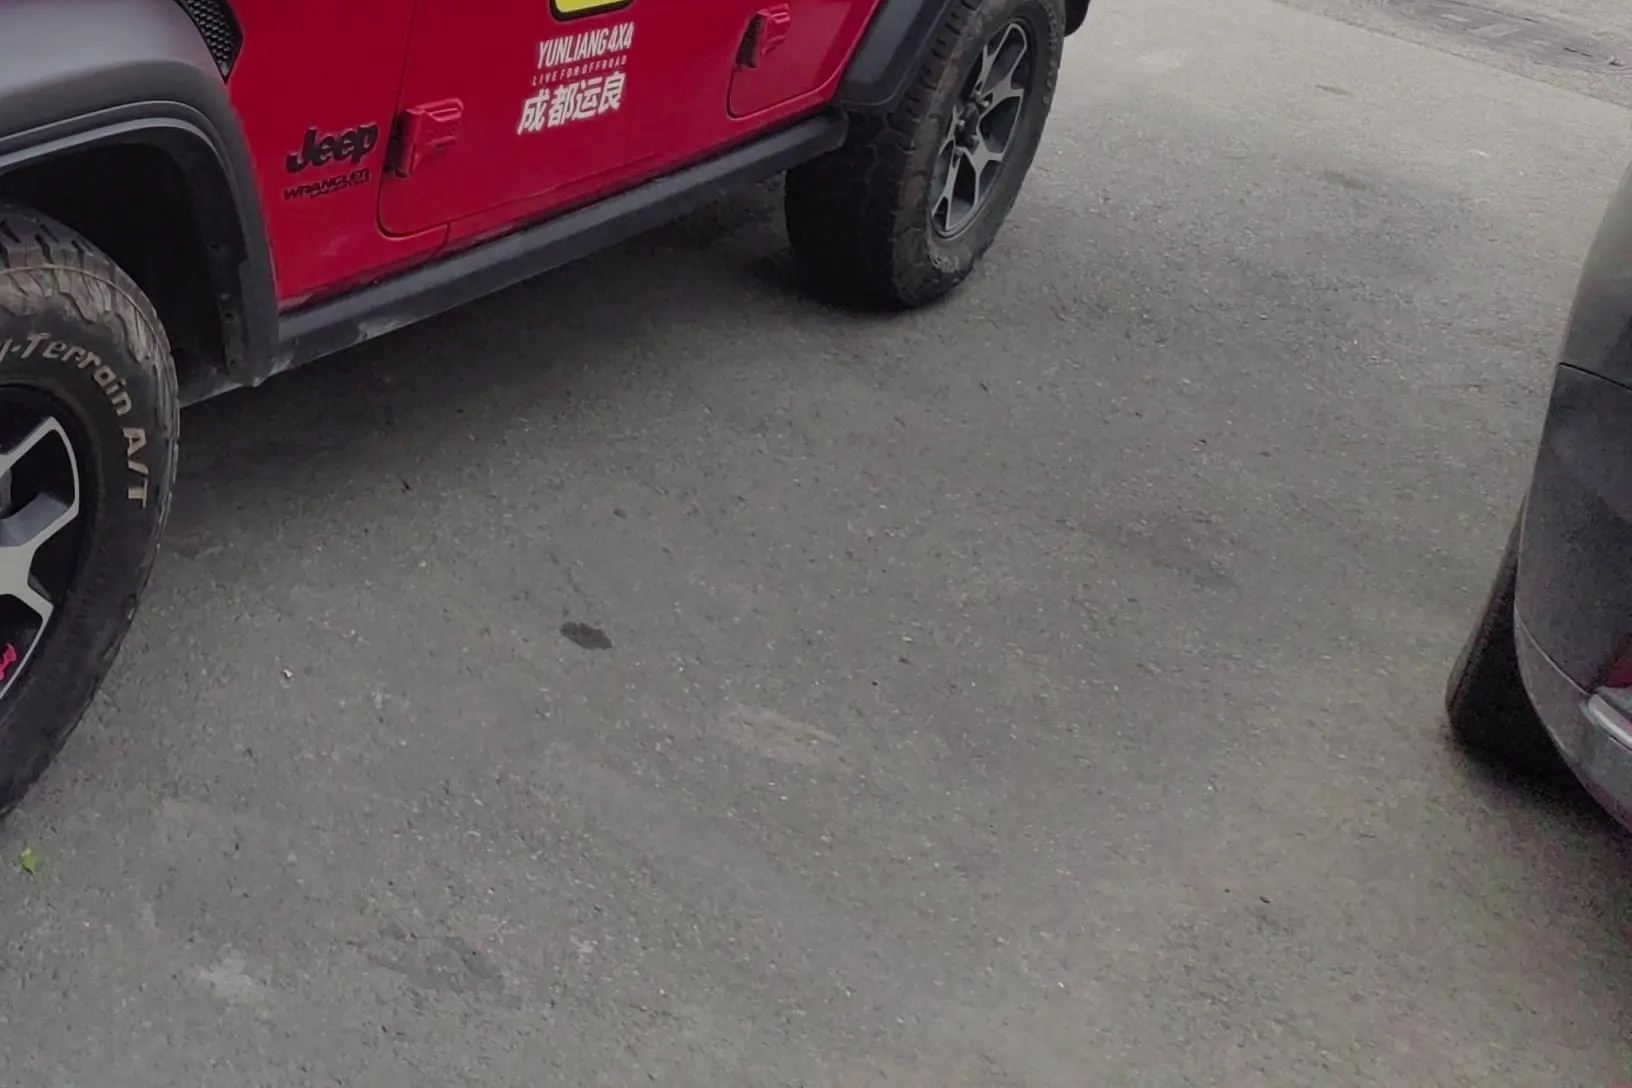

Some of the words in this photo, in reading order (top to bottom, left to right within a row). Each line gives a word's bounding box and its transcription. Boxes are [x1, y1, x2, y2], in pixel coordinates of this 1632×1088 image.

[532, 71, 558, 87] LIVE
[559, 66, 580, 83] FOR
[581, 54, 628, 75] OFFROAD
[517, 71, 626, 135] 成都运良
[286, 121, 378, 174] Jeep
[122, 427, 149, 508] A/T
